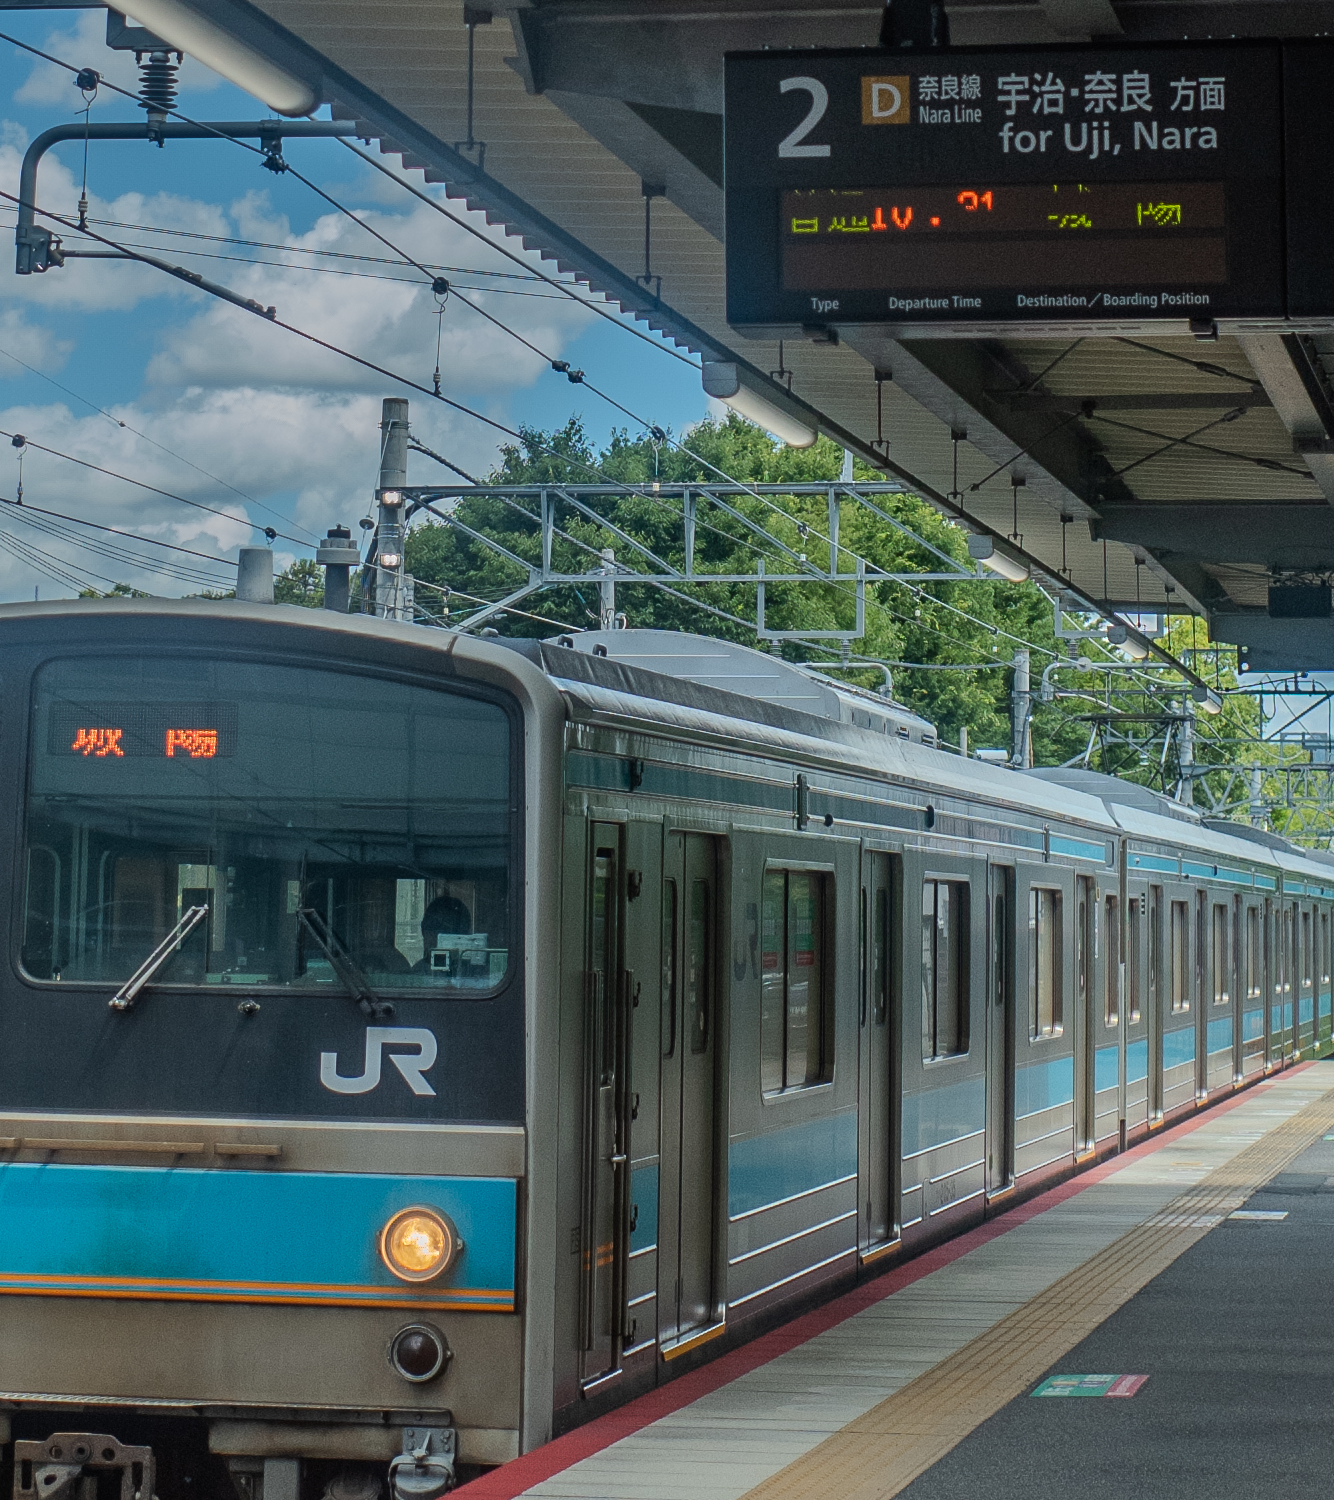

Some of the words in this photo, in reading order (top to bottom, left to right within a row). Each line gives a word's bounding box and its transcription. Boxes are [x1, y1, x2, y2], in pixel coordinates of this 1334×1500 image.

[871, 83, 901, 117] D
[918, 74, 982, 100] 奈良線
[1170, 76, 1226, 111] 方面
[778, 76, 831, 158] 2
[919, 105, 951, 123] Nara
[954, 104, 982, 123] Line
[999, 122, 1053, 153] for
[1064, 121, 1121, 159] Uji,
[1134, 121, 1217, 150] Nara
[810, 297, 840, 313] Type
[889, 296, 949, 312] Departure
[952, 295, 982, 308] Time
[1161, 292, 1210, 306] Position
[320, 1026, 438, 1096] JR
